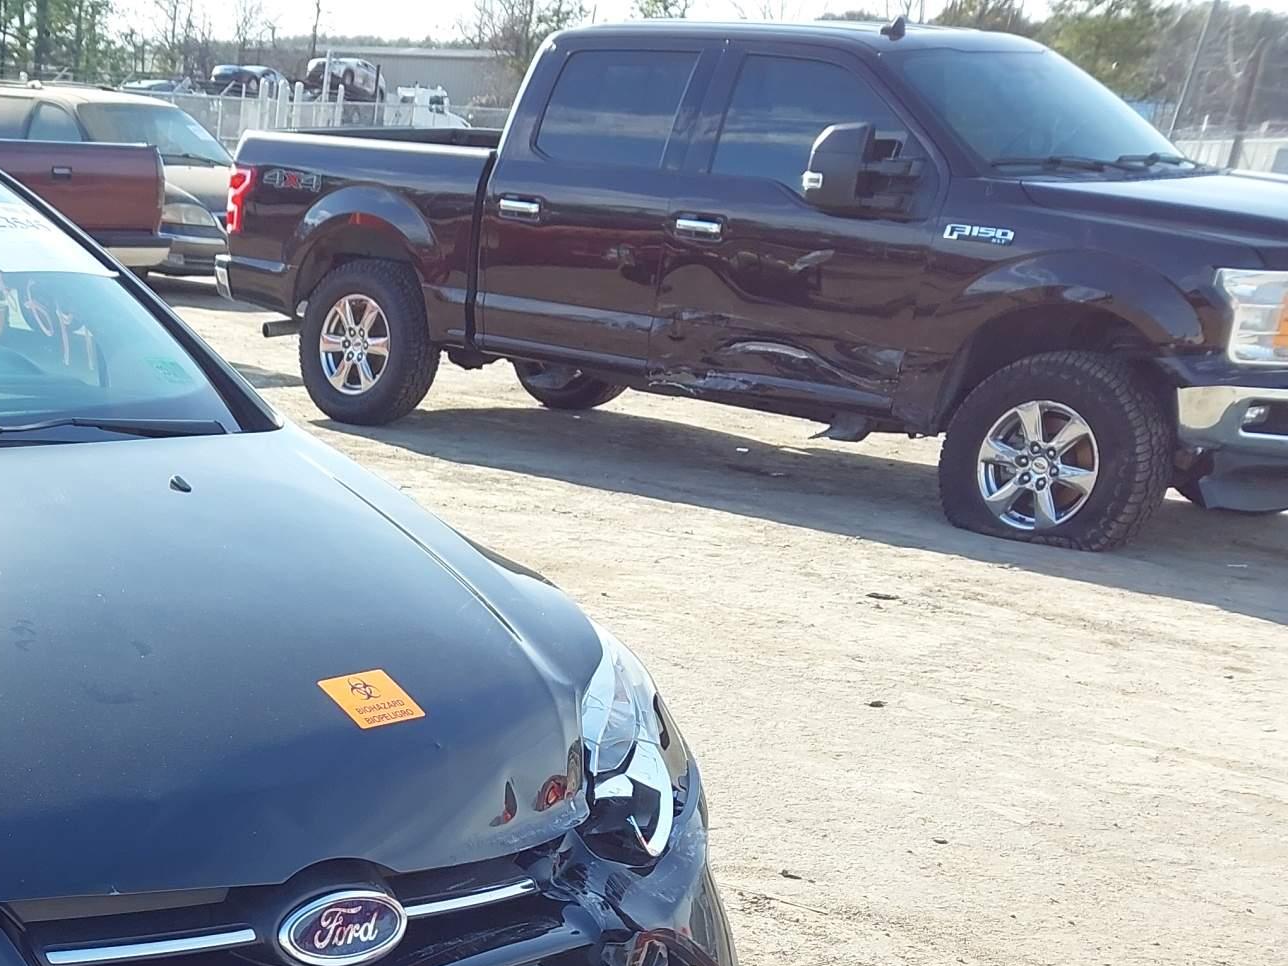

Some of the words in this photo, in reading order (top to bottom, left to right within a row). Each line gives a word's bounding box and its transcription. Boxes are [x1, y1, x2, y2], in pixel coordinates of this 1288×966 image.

[356, 699, 406, 715] BIOHAZARD
[364, 708, 415, 725] BIOPELIGRO
[314, 906, 379, 949] Ford
